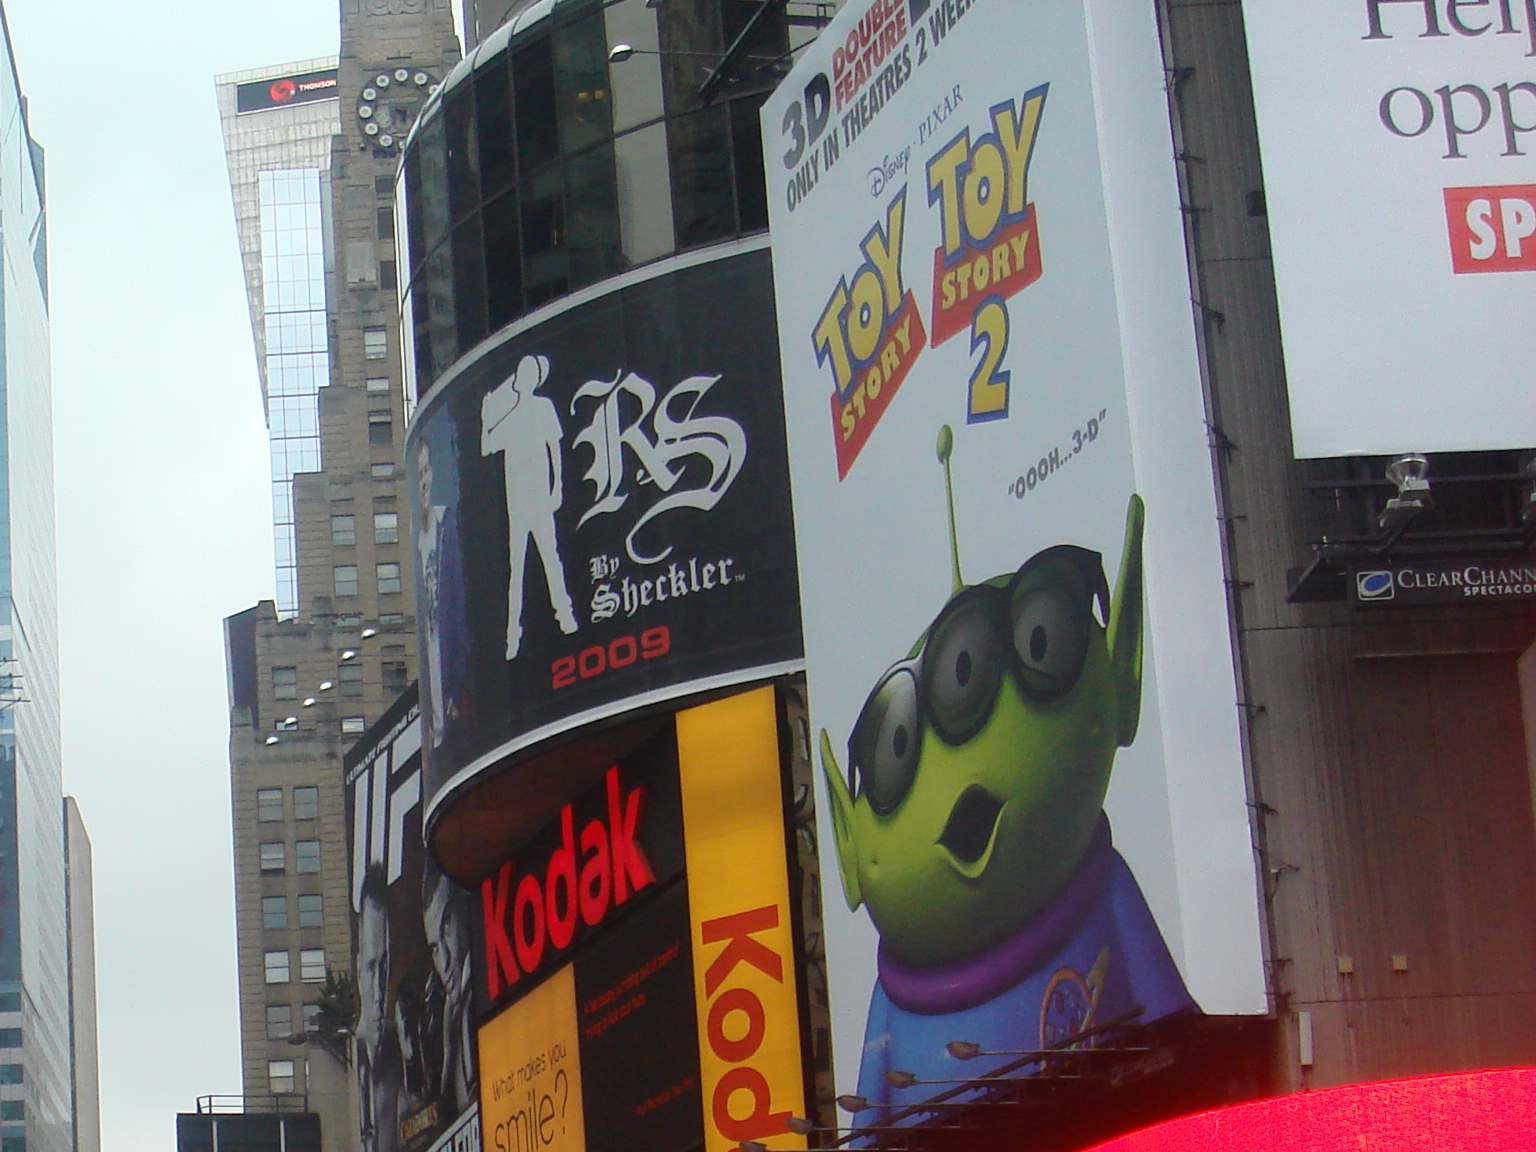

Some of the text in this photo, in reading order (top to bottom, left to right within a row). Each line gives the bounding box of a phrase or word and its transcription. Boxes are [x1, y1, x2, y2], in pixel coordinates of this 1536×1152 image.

[835, 6, 907, 114] FEATURE
[1361, 0, 1536, 57] Hel
[298, 80, 337, 92] THOMSON
[782, 72, 831, 170] 3D
[787, 148, 819, 212] ONLY
[823, 127, 839, 172] IN
[841, 43, 912, 148] THEATRES
[915, 27, 928, 67] 2
[918, 84, 964, 146] PIXAR
[925, 82, 1051, 267] TOY
[811, 183, 908, 406] TOY
[941, 230, 1031, 311] STORY
[841, 313, 912, 443] STORY
[966, 293, 1012, 425] 2
[590, 553, 620, 584] By
[590, 556, 735, 623] Sheckler
[551, 625, 671, 690] 2009
[480, 764, 657, 1000] Kodak
[517, 1054, 546, 1086] makes
[547, 1040, 566, 1070] you
